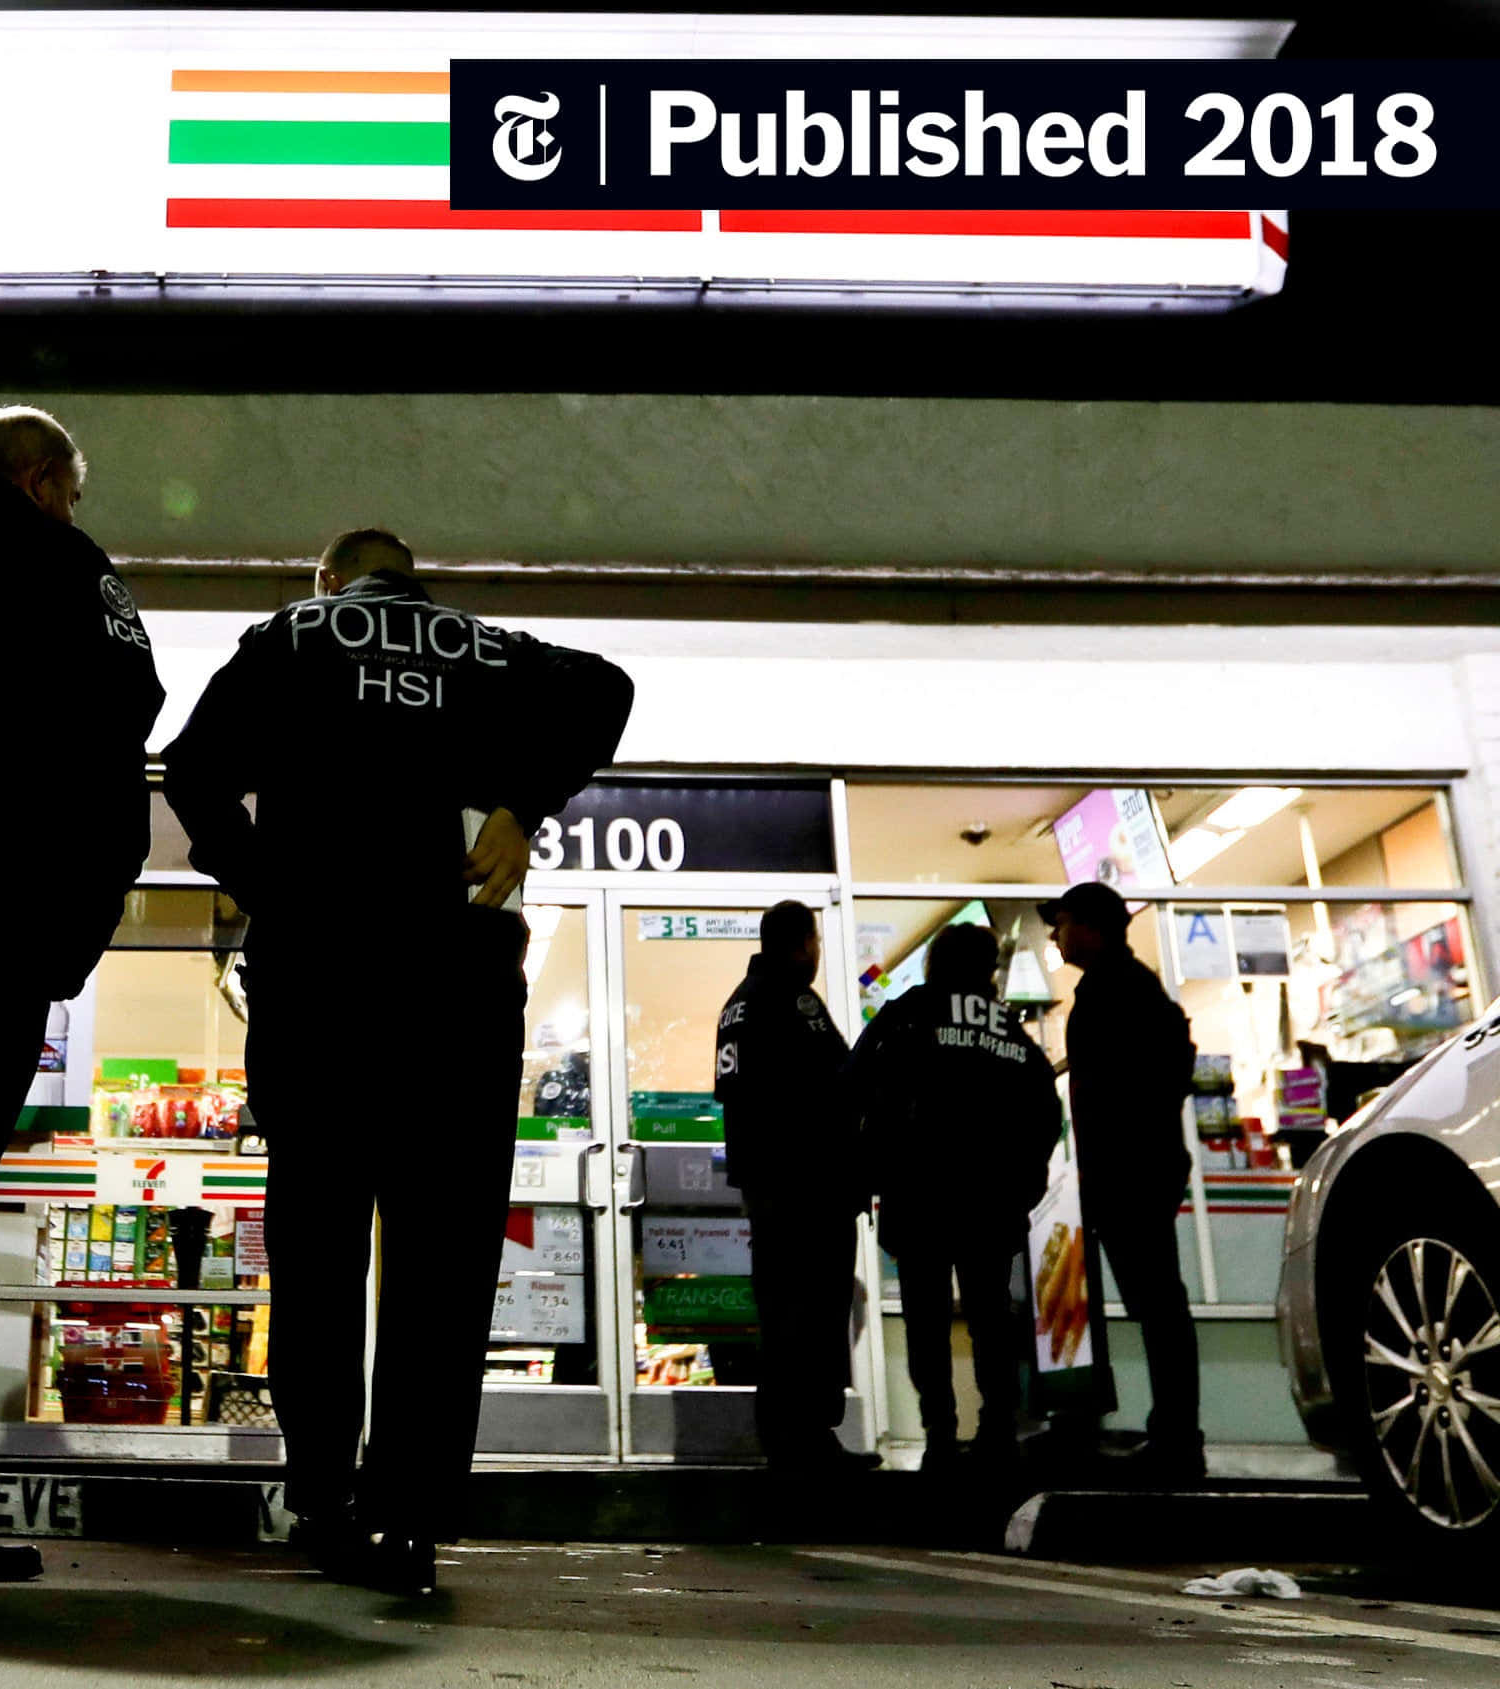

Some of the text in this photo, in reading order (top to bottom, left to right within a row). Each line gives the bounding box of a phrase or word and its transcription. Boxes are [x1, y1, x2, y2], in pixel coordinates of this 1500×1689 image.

[103, 613, 150, 650] ICE
[289, 602, 508, 666] POLICE
[357, 665, 443, 709] HSI
[530, 815, 686, 871] 3100
[1187, 911, 1218, 944] A
[950, 993, 1008, 1037] ICE
[936, 1027, 1027, 1063] UBLIC AFFAIRS
[652, 1122, 677, 1134] Pull
